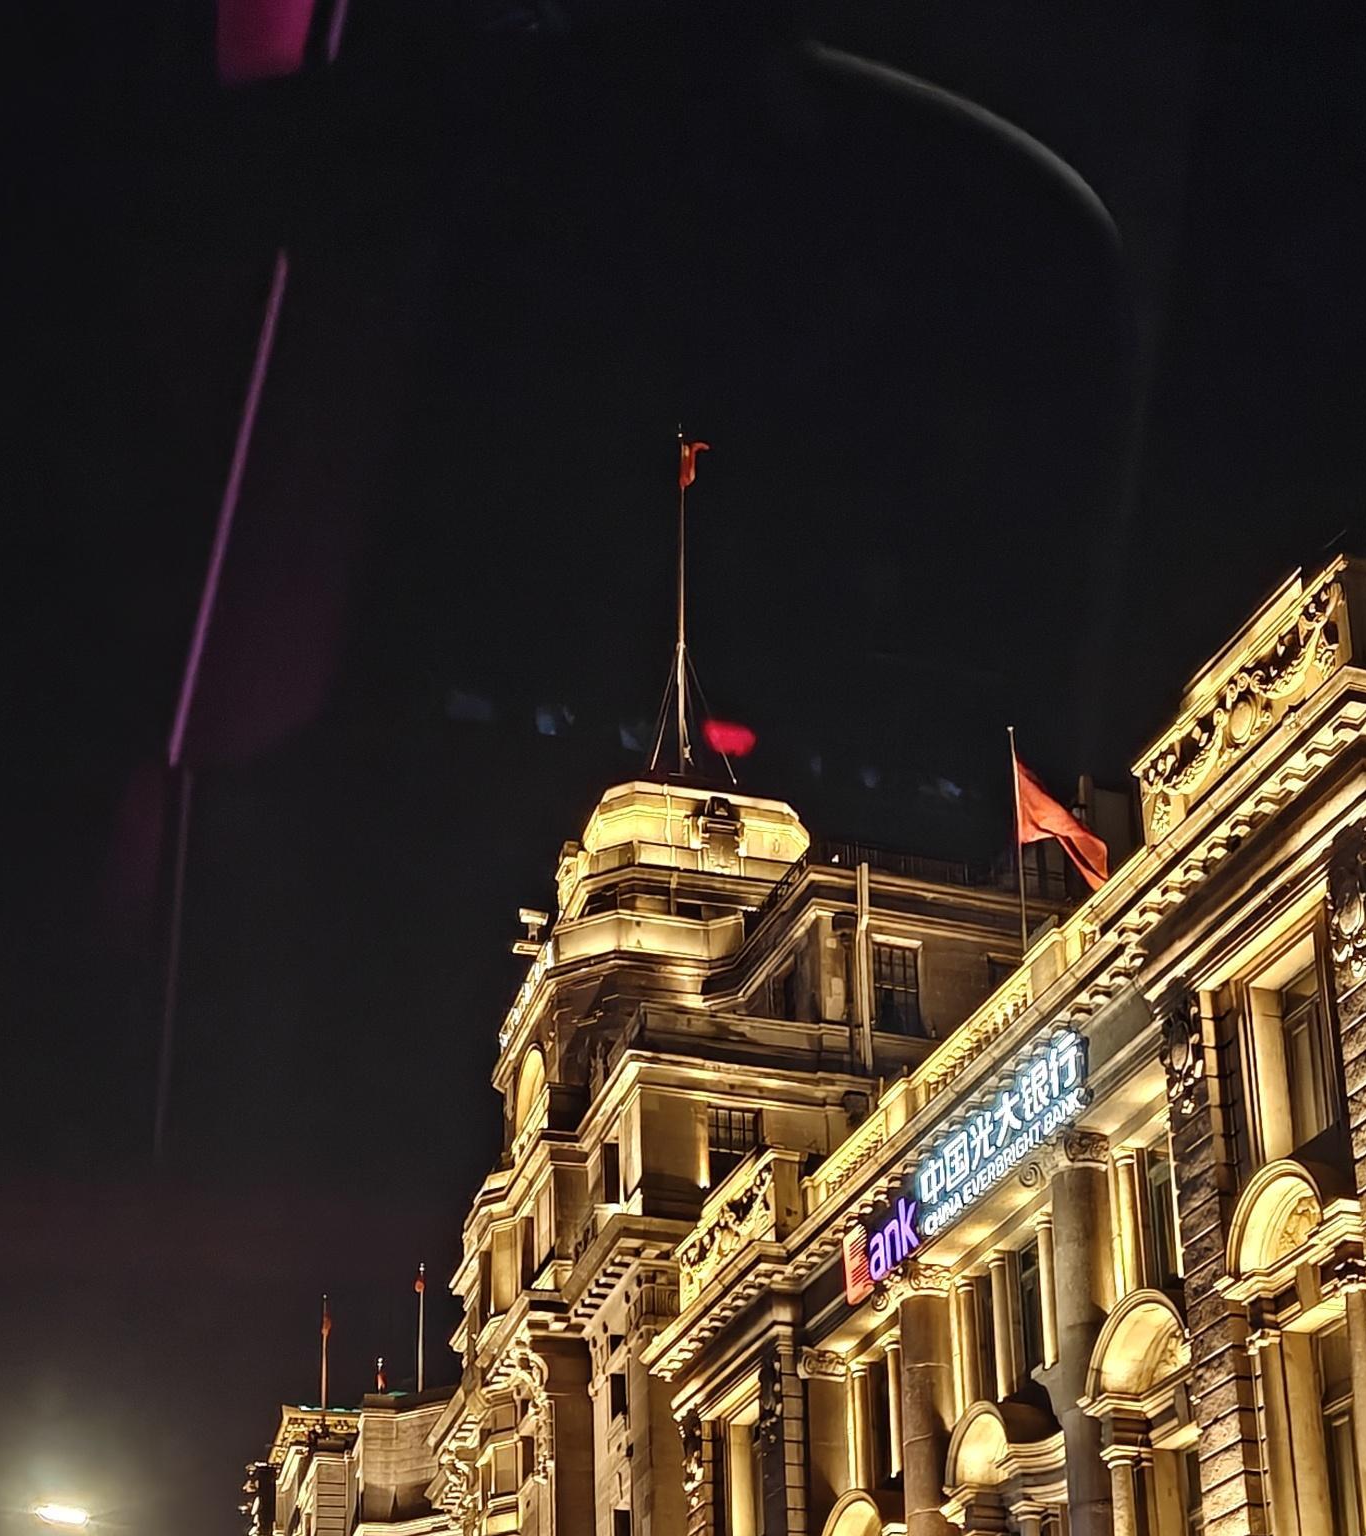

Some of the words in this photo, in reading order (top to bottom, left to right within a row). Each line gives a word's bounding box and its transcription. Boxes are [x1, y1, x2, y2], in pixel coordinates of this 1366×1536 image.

[920, 1031, 1079, 1204] 中国光大银行
[924, 1192, 964, 1236] CHINA
[962, 1121, 1043, 1204] EVERBRIGHT
[1042, 1088, 1087, 1137] BANK
